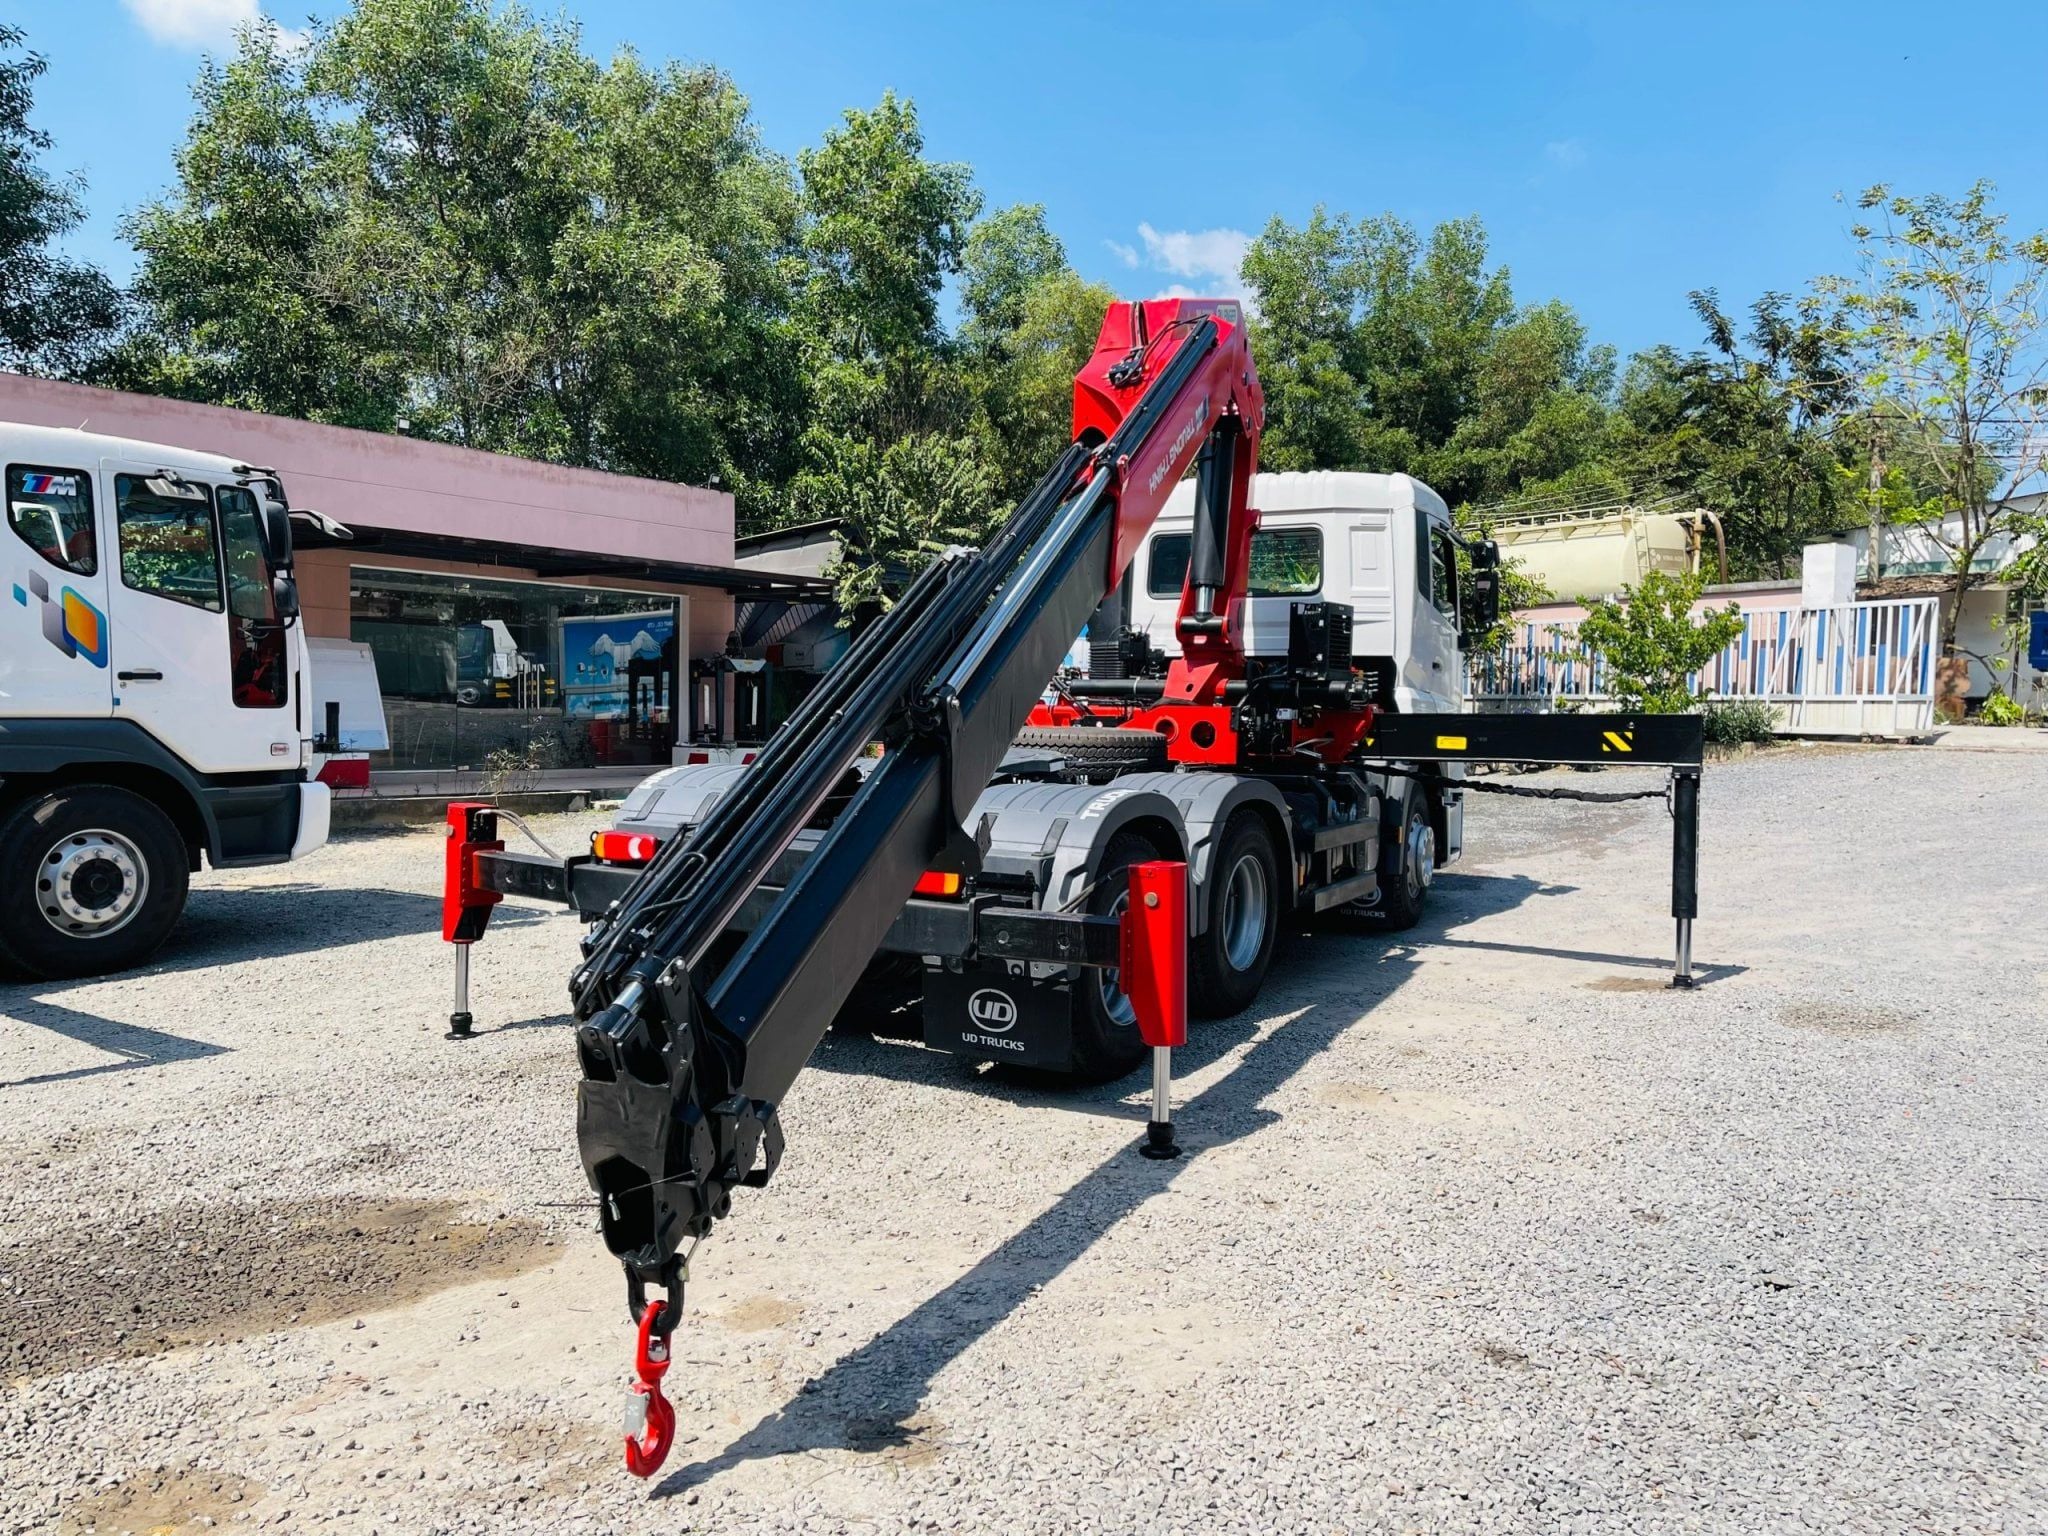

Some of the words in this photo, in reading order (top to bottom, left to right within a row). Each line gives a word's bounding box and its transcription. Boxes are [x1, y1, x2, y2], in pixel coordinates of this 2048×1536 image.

[1518, 572, 1546, 581] ORLD
[1353, 908, 1386, 918] TRUCKS
[972, 998, 1013, 1022] UD
[961, 1032, 978, 1043] UD
[979, 1035, 1025, 1052] TRUCKS
